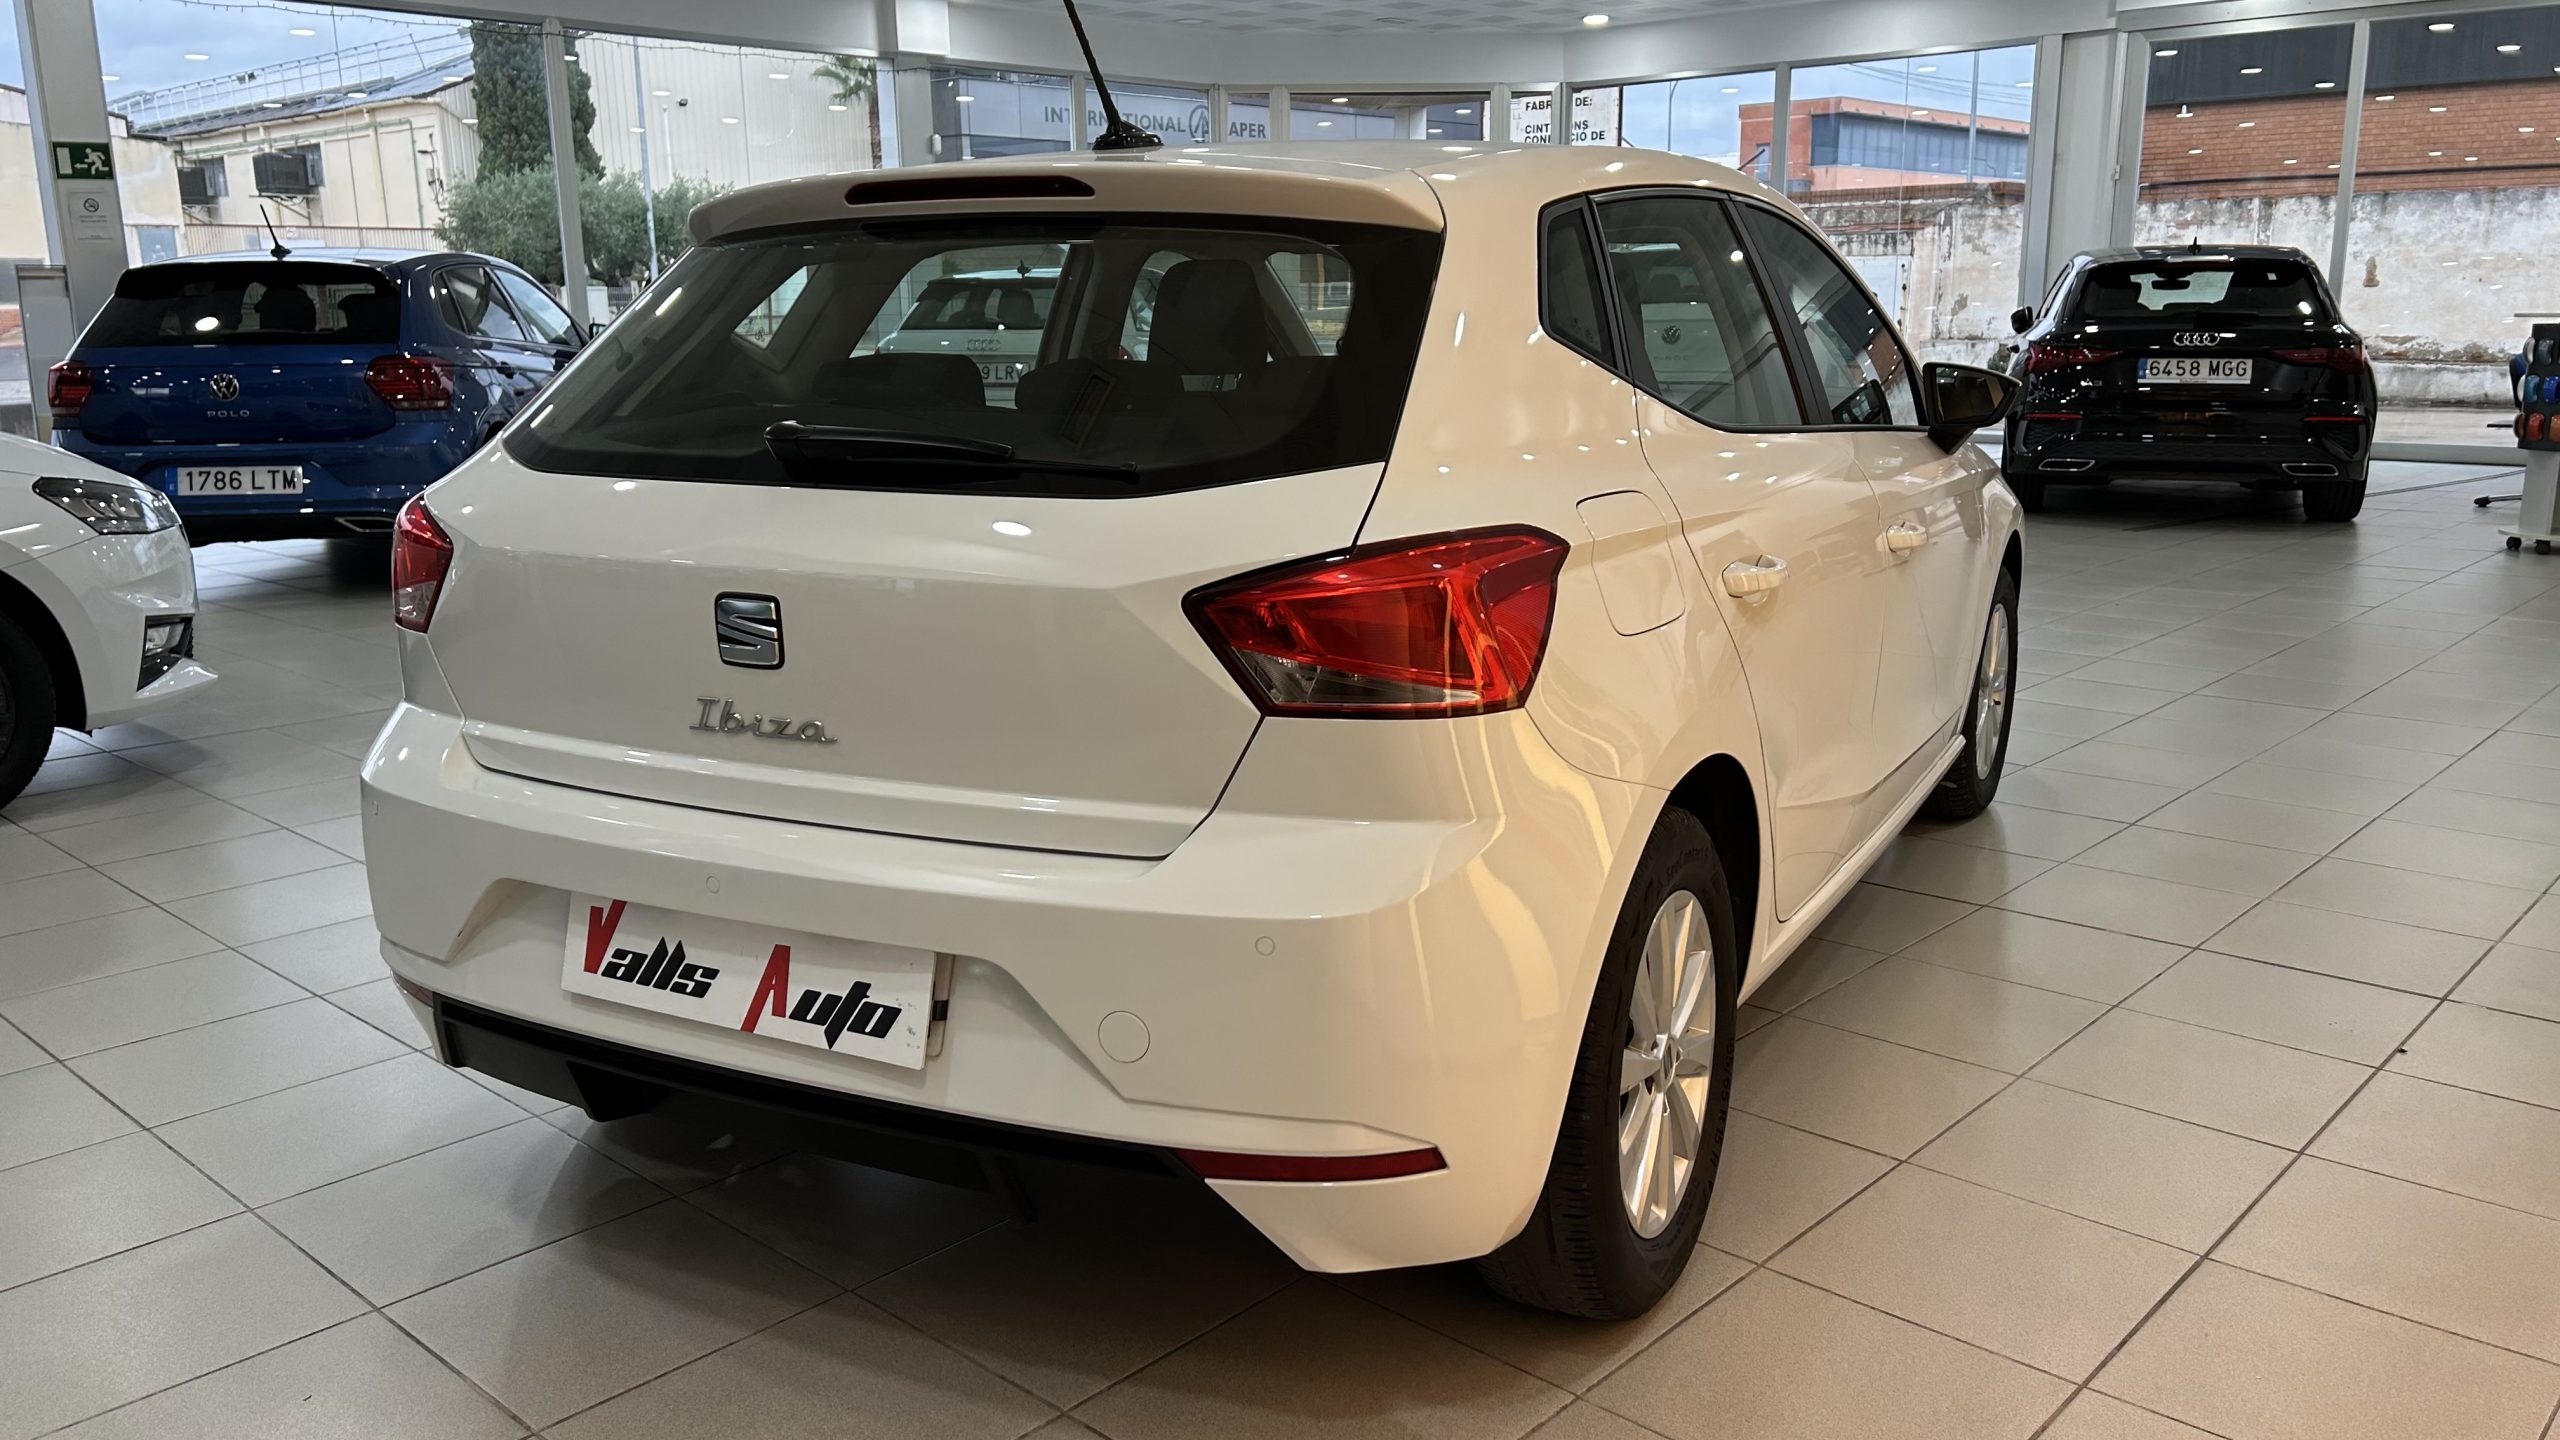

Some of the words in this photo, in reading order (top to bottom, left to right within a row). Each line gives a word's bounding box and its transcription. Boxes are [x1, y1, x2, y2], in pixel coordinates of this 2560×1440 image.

[1044, 106, 1186, 132] INTRNTIONAL
[1228, 121, 1267, 139] APER
[1591, 130, 1606, 141] DE
[2149, 360, 2201, 377] 6458
[2208, 360, 2248, 377] MGG
[207, 409, 250, 418] POLO
[186, 470, 242, 492] 1786
[251, 469, 297, 490] LTM
[689, 696, 838, 743] Ibiza
[583, 900, 721, 999] Valls
[740, 943, 903, 1050] Auto
